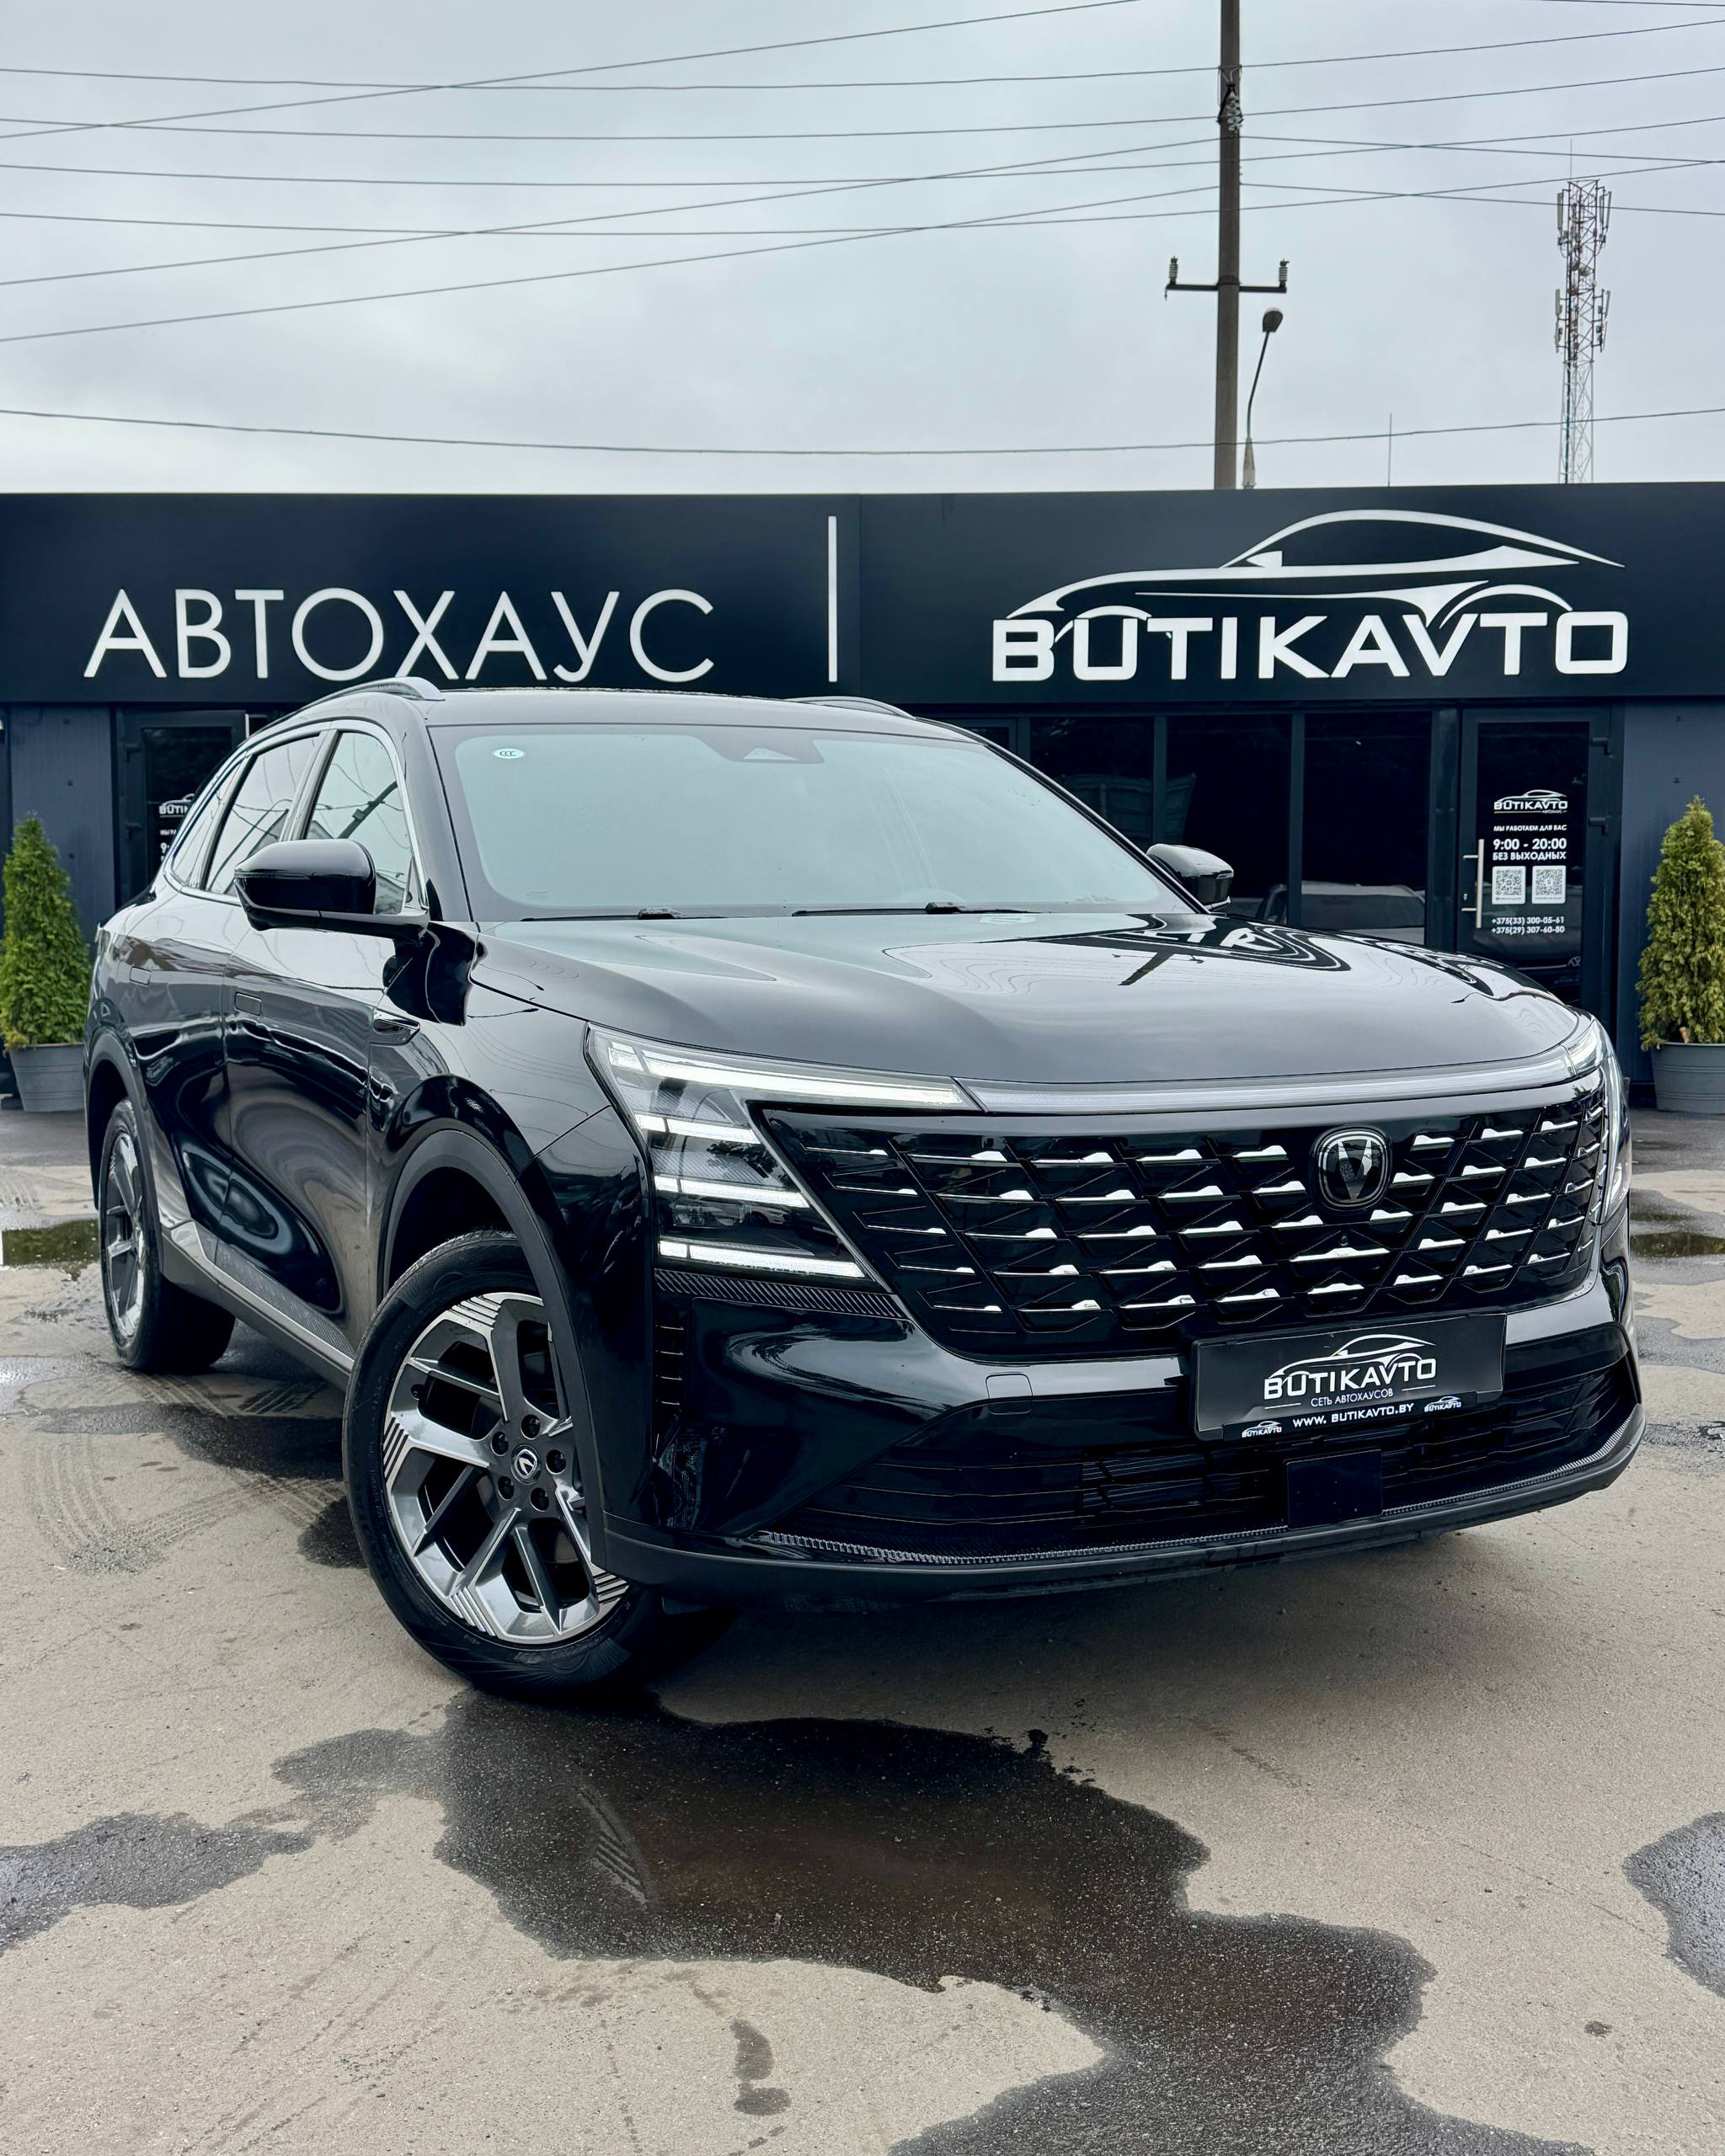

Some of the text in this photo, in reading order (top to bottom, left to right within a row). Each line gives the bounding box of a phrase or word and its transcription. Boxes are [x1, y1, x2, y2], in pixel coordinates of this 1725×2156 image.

[84, 588, 714, 683] АВТОХАУС
[992, 611, 1629, 682] BUTIKAVTO
[1493, 800, 1567, 810] BUTIKAVTO
[1493, 838, 1520, 851] 9:00
[1531, 837, 1567, 850] 20:00
[1493, 851, 1567, 861] БЕЗ ВЫХОДНЫХ
[1491, 917, 1525, 926] +375(33)
[1491, 926, 1525, 935] +375(29)
[1264, 1358, 1436, 1400] BUTIKAVTO
[1311, 1388, 1394, 1407] СЕТЬ АВТОХАУСОВ
[1423, 1401, 1462, 1412] BUTIKAVTO
[1292, 1402, 1415, 1428] WWW. BUTIKAVTO.BY
[1241, 1426, 1283, 1438] BUTIKAVTO
